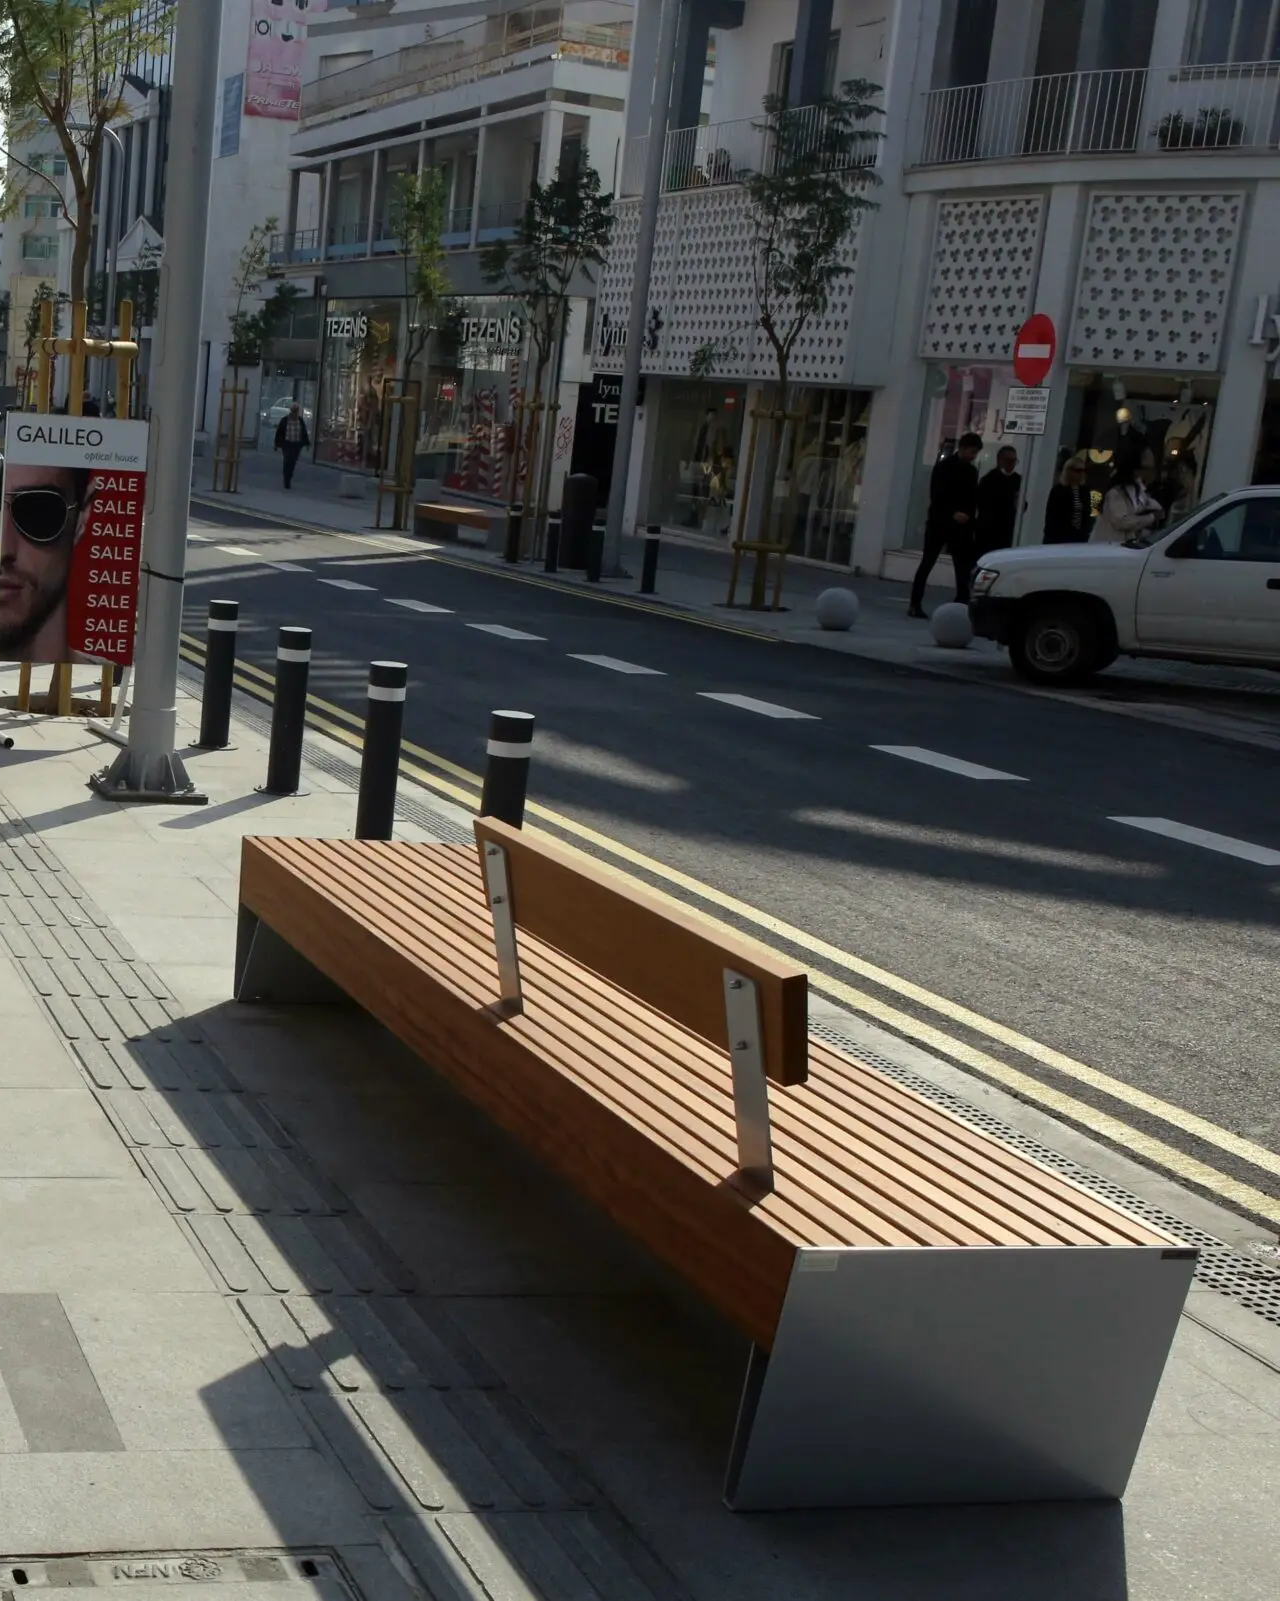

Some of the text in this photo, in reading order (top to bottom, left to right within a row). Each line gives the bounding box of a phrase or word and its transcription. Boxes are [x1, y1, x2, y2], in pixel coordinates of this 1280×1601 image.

[325, 312, 368, 339] TEZENIS
[461, 310, 521, 345] TEZENIS
[16, 425, 103, 447] GALILEO
[85, 452, 139, 464] optical house
[94, 475, 138, 493] SALE
[93, 499, 137, 516] SALE
[91, 522, 135, 539] SALE
[90, 545, 134, 562] SALE
[88, 569, 132, 586] SALE
[87, 594, 130, 610] SALE
[85, 618, 129, 634] SALE
[83, 638, 127, 653] SALE
